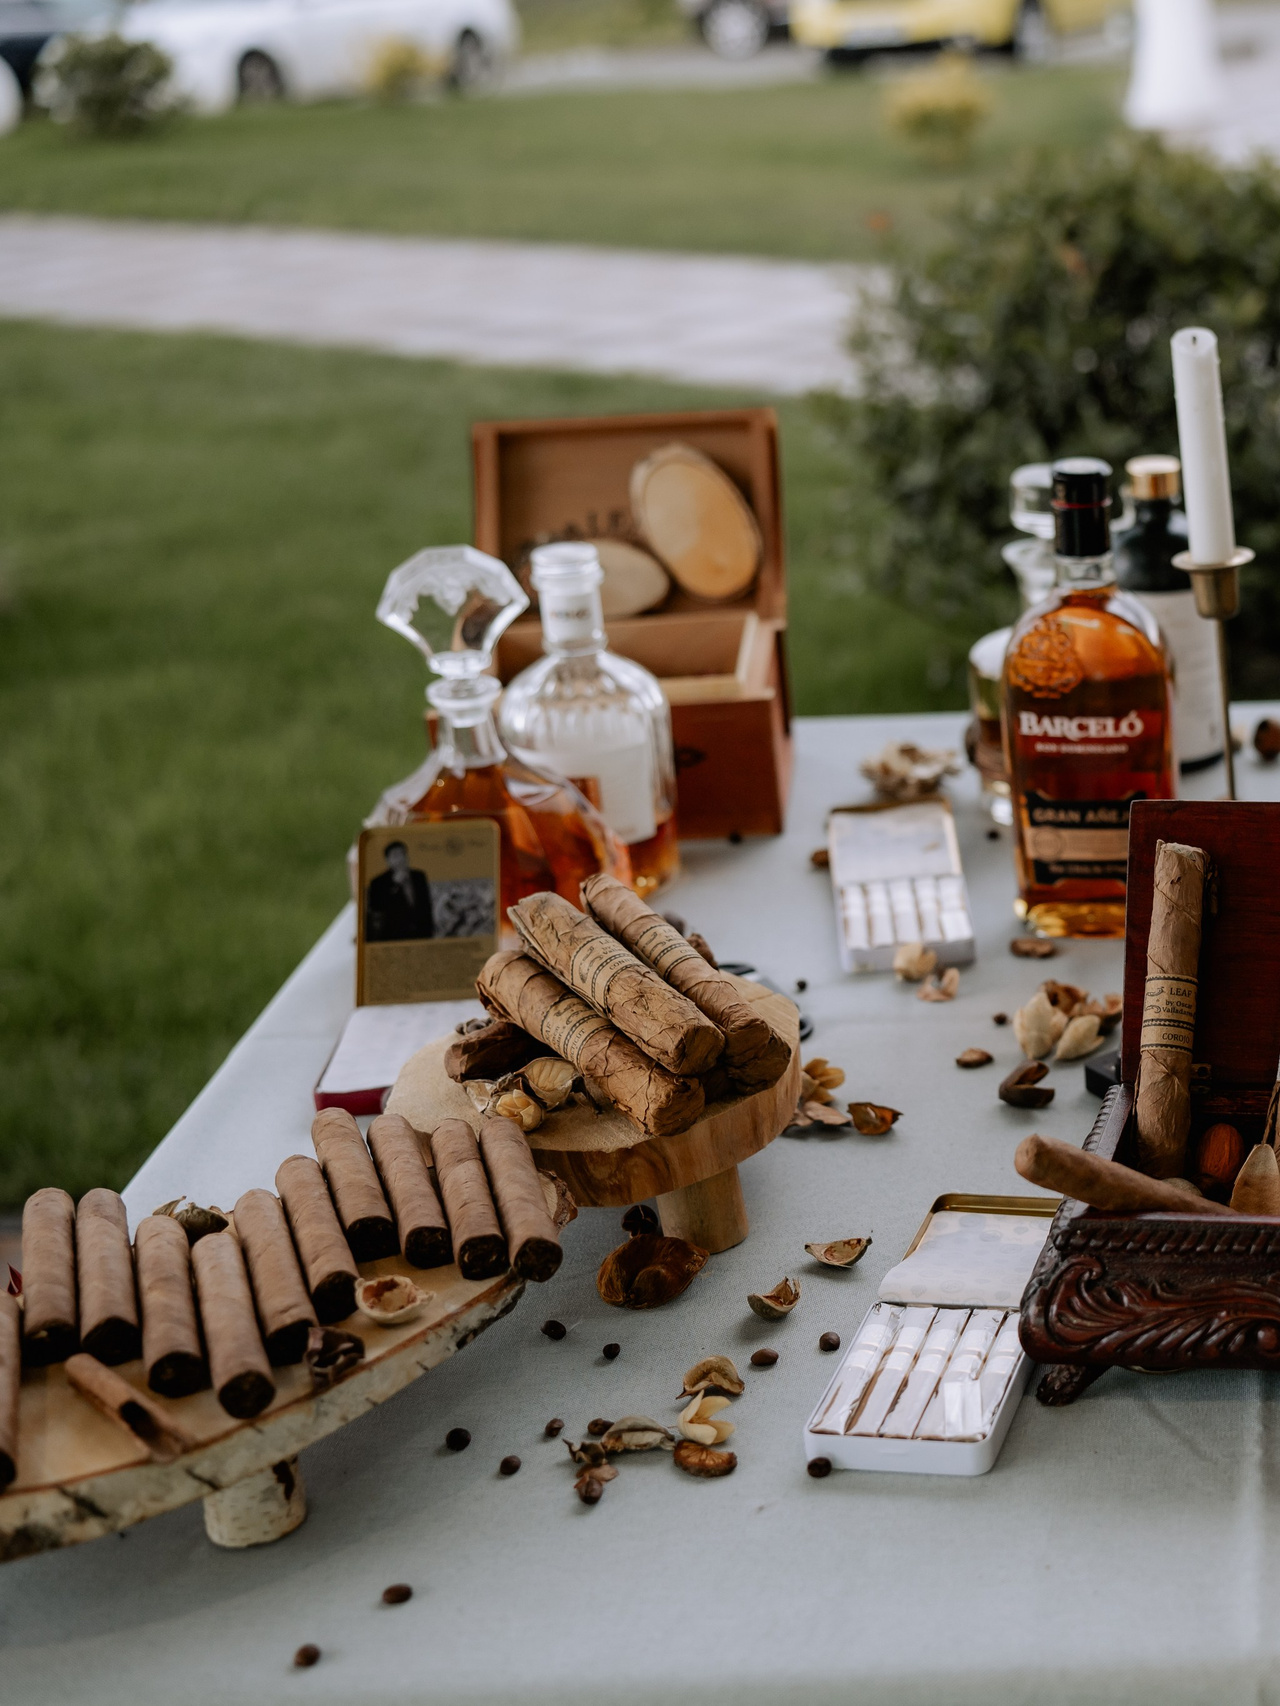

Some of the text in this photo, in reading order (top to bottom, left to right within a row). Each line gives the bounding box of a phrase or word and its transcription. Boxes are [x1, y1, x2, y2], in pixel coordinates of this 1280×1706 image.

[1019, 709, 1145, 741] BARCELÓ
[1033, 807, 1129, 823] GRAN AÑEJ
[1169, 987, 1192, 998] LEAF
[1162, 1033, 1190, 1044] COROJO
